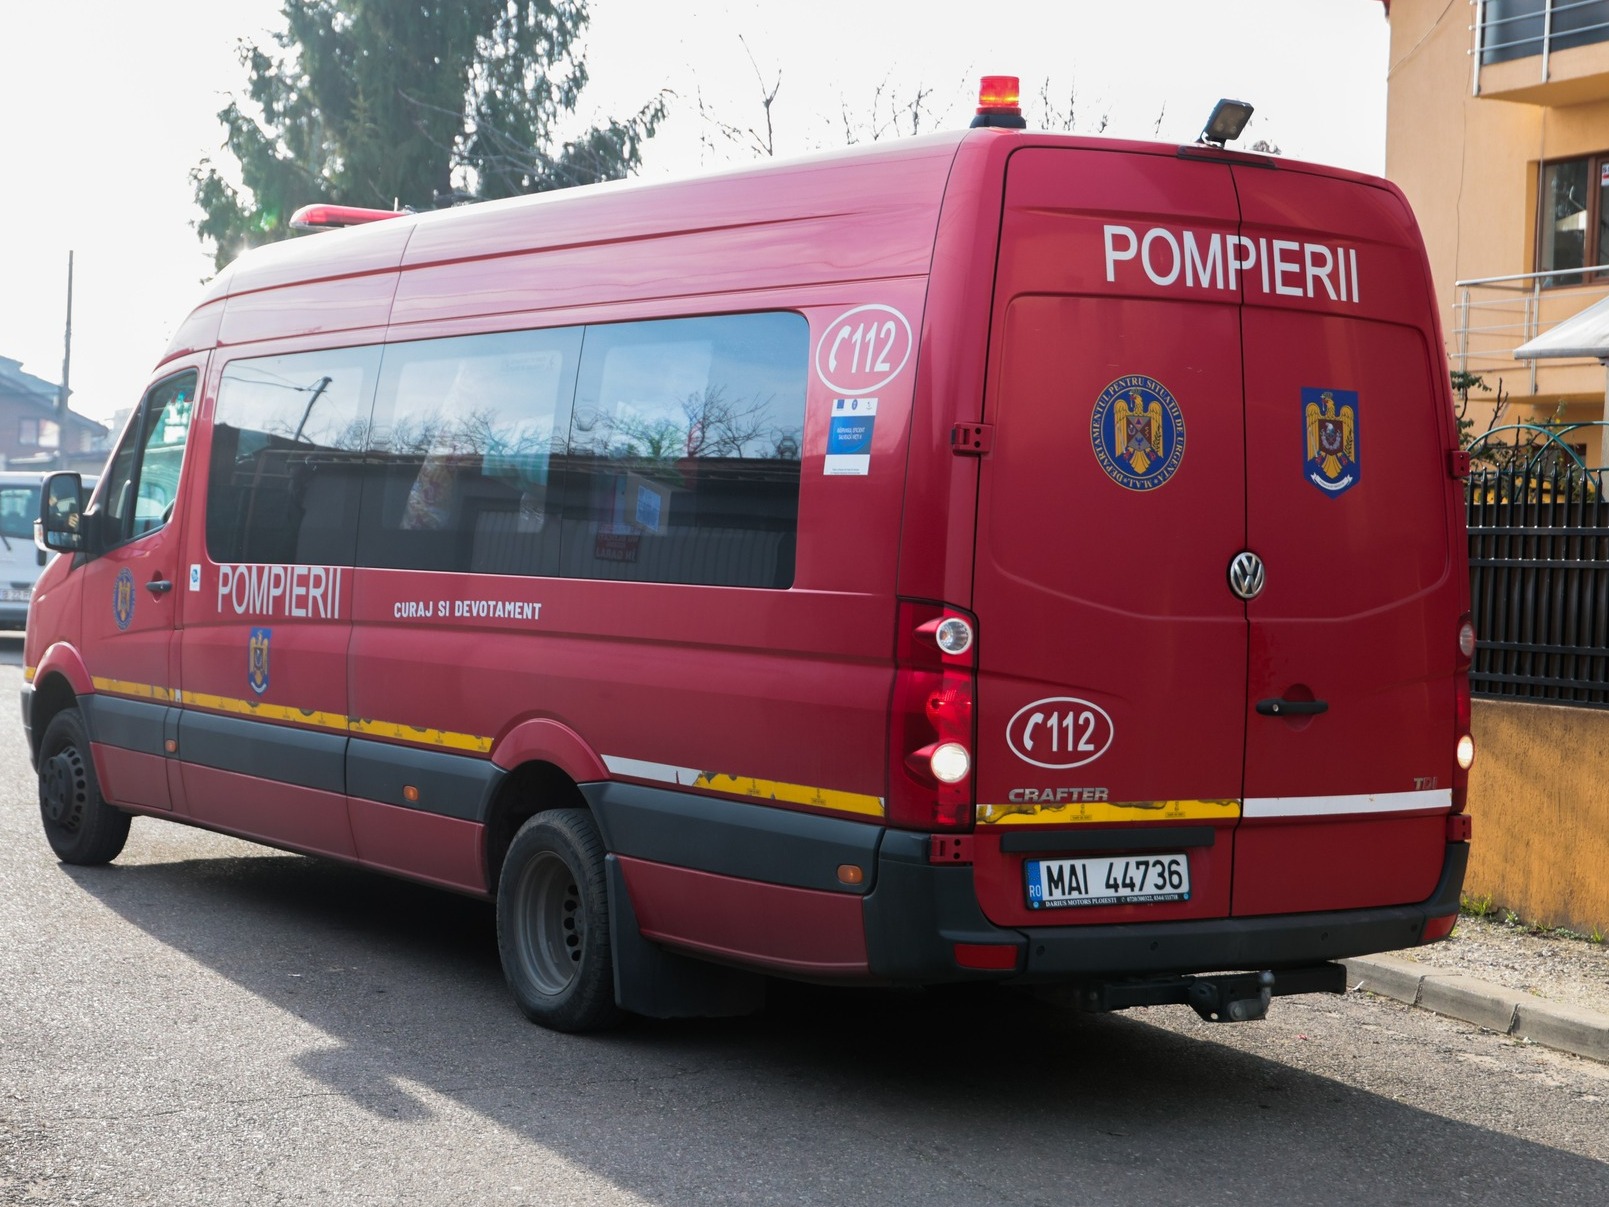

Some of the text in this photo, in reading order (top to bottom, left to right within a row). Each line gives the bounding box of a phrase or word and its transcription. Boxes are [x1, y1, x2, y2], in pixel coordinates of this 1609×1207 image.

[1103, 224, 1359, 303] POMPIERII
[851, 320, 896, 374] 112
[1108, 377, 1144, 395] PENTRU
[1175, 418, 1184, 432] DE
[217, 565, 342, 619] POMPIERII
[394, 600, 542, 620] CURAJ SI DEVOTAMENT
[1046, 711, 1095, 752] 112
[1008, 787, 1109, 803] CRAFTER
[1029, 884, 1042, 898] RO
[1046, 858, 1183, 897] MAI 44736
[1067, 898, 1092, 906] MOTORS
